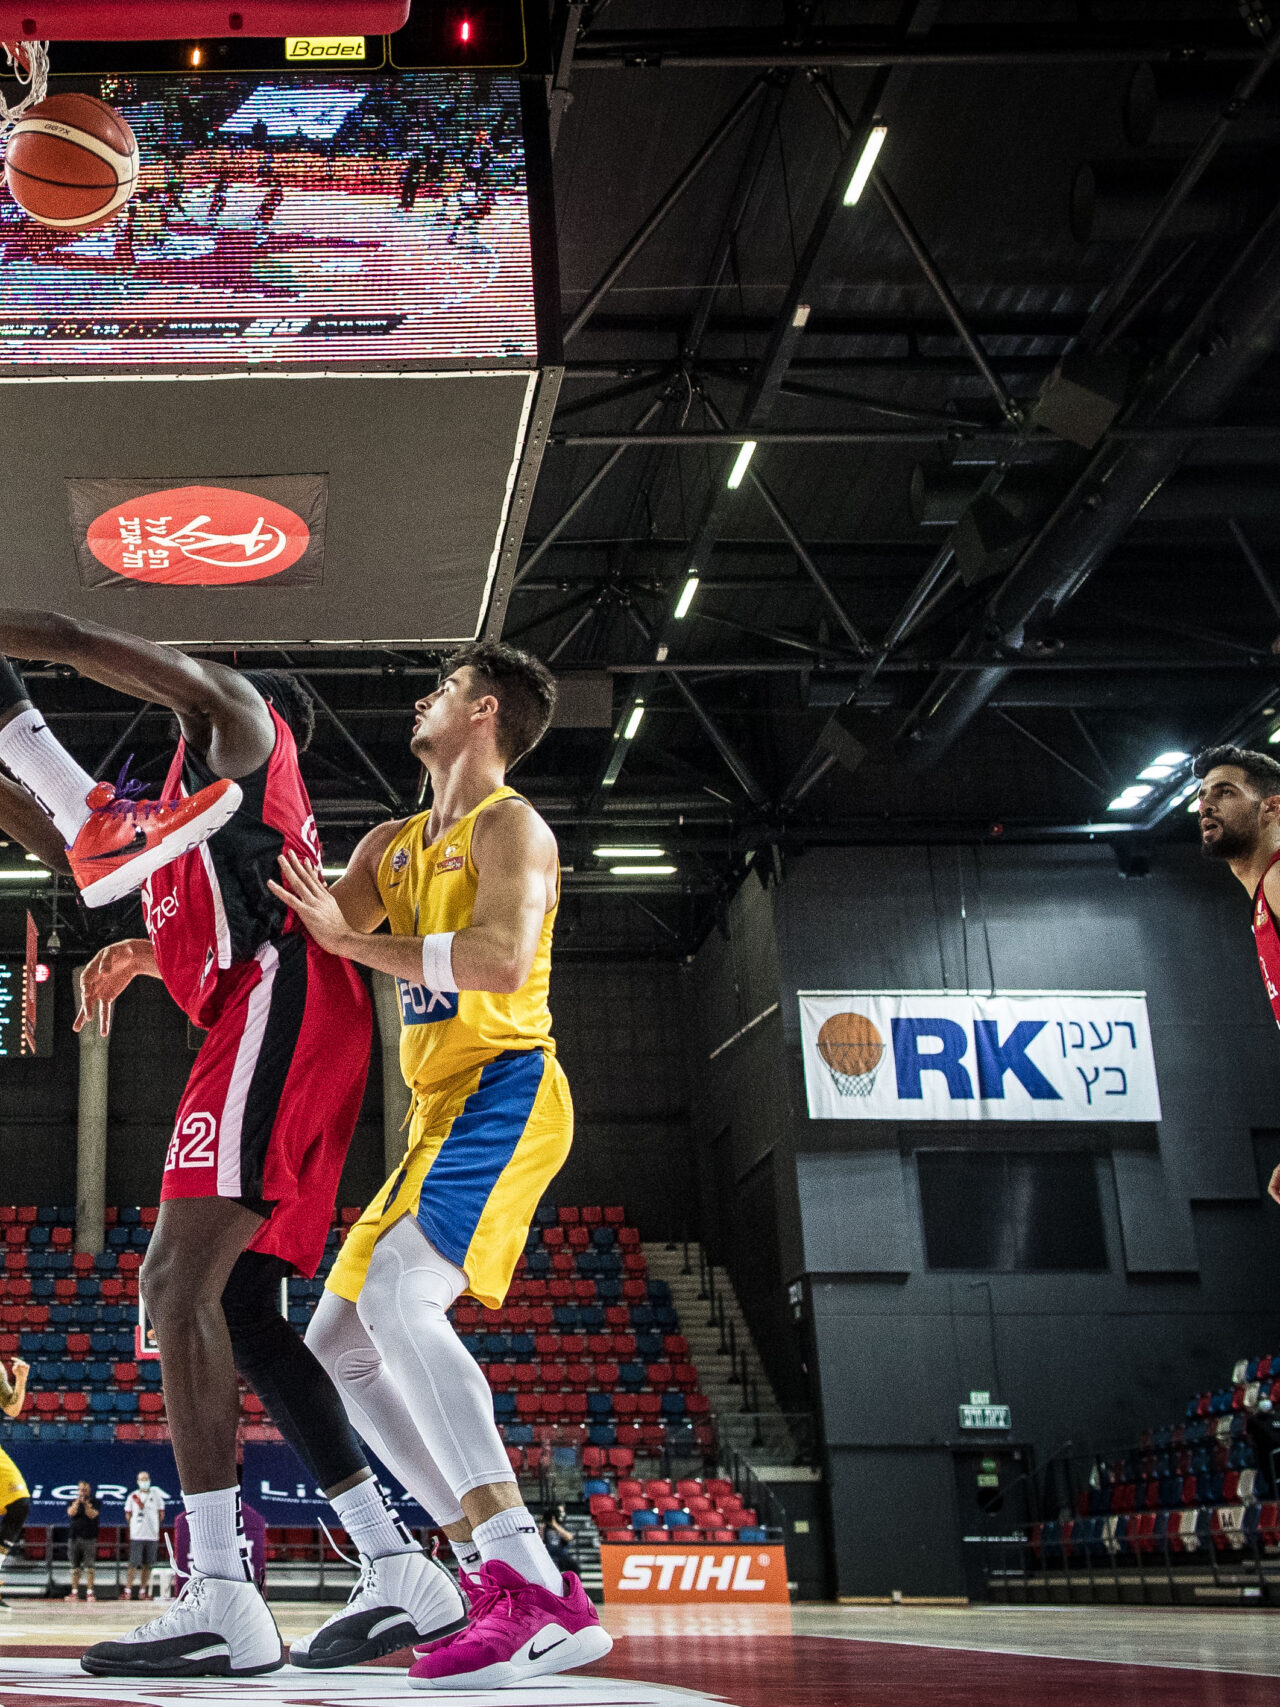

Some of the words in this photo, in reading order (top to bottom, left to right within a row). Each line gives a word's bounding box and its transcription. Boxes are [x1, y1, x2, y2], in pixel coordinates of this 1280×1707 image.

[289, 41, 362, 56] Bodet
[1056, 1019, 1138, 1058] רענן
[891, 1017, 1064, 1100] RK
[1077, 1066, 1128, 1105] כץ
[617, 1554, 767, 1591] STIHL
